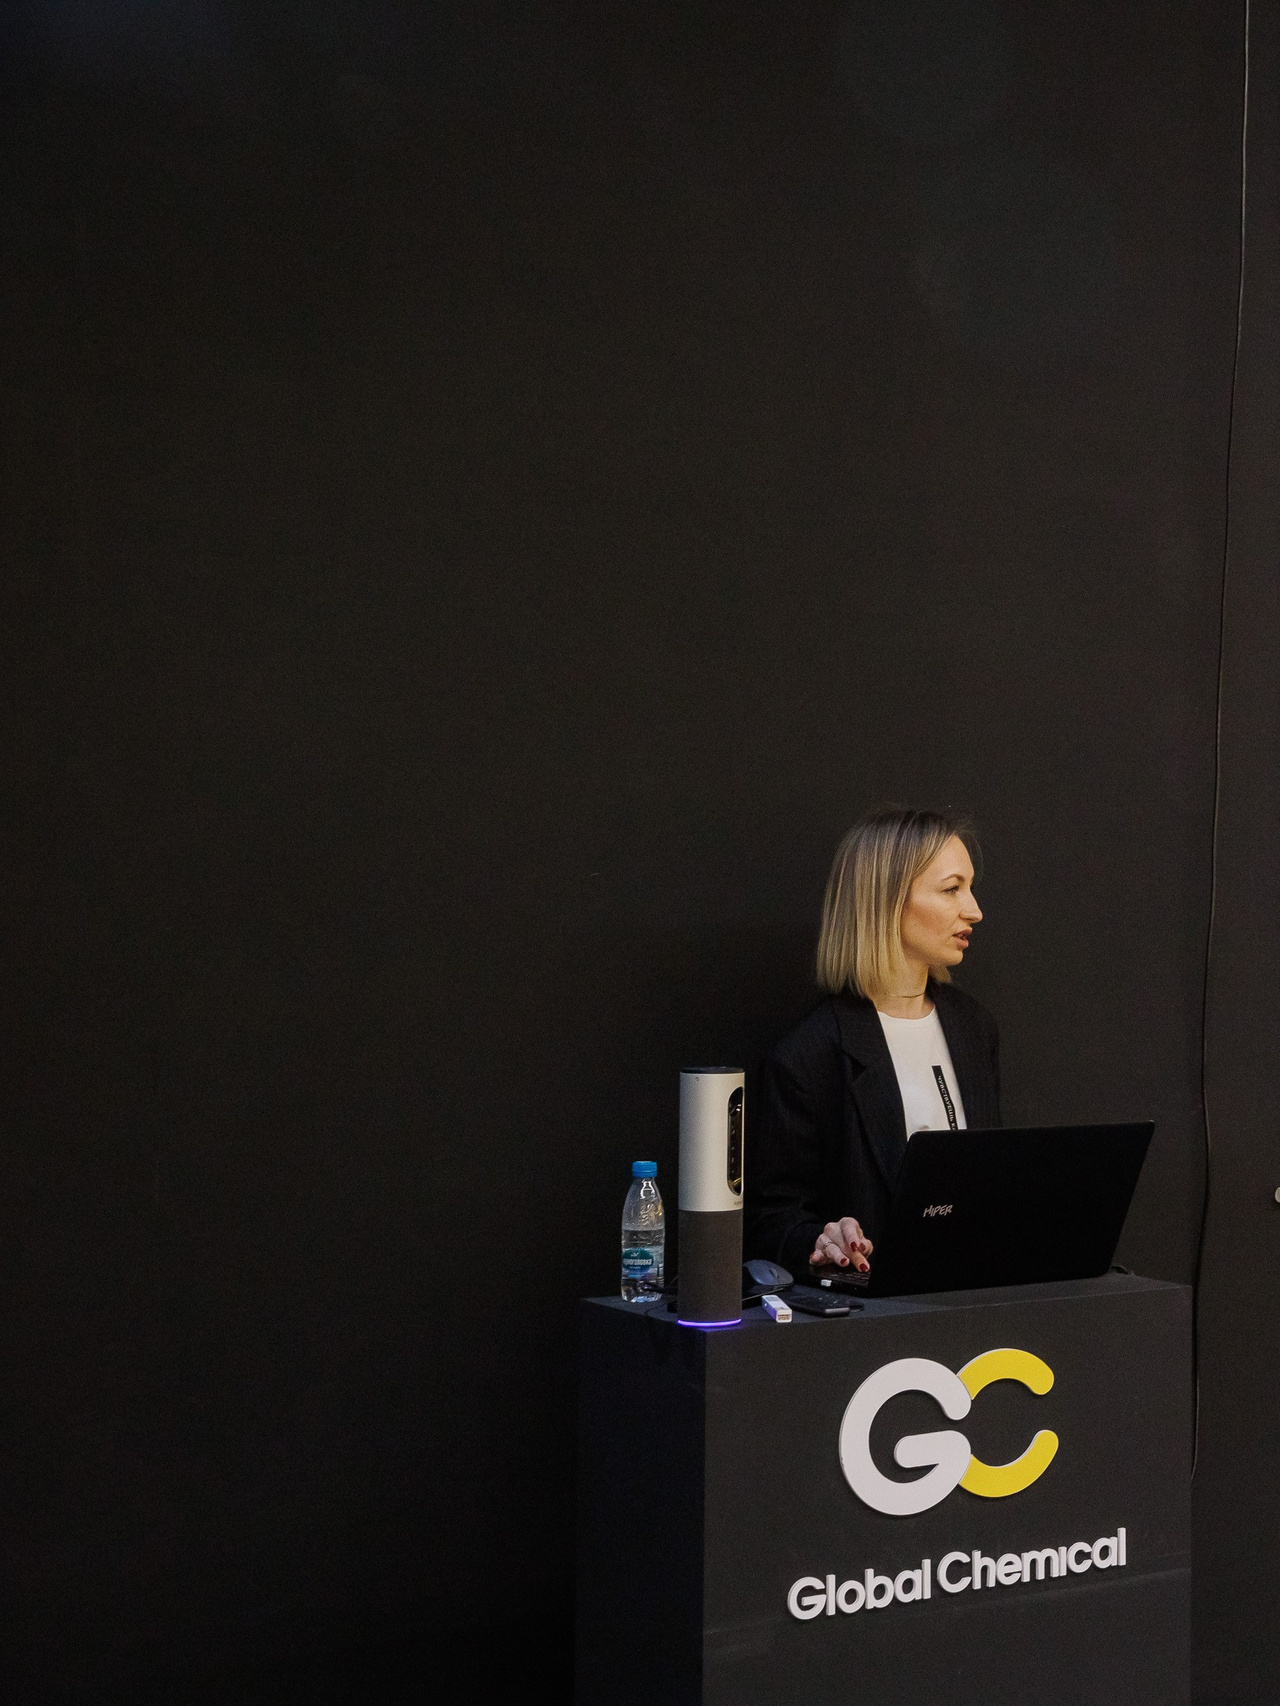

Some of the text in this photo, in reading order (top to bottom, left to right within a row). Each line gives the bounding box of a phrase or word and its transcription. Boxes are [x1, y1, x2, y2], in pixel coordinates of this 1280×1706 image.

[923, 1204, 953, 1218] HIPER
[787, 1527, 1127, 1620] Global Chemical
